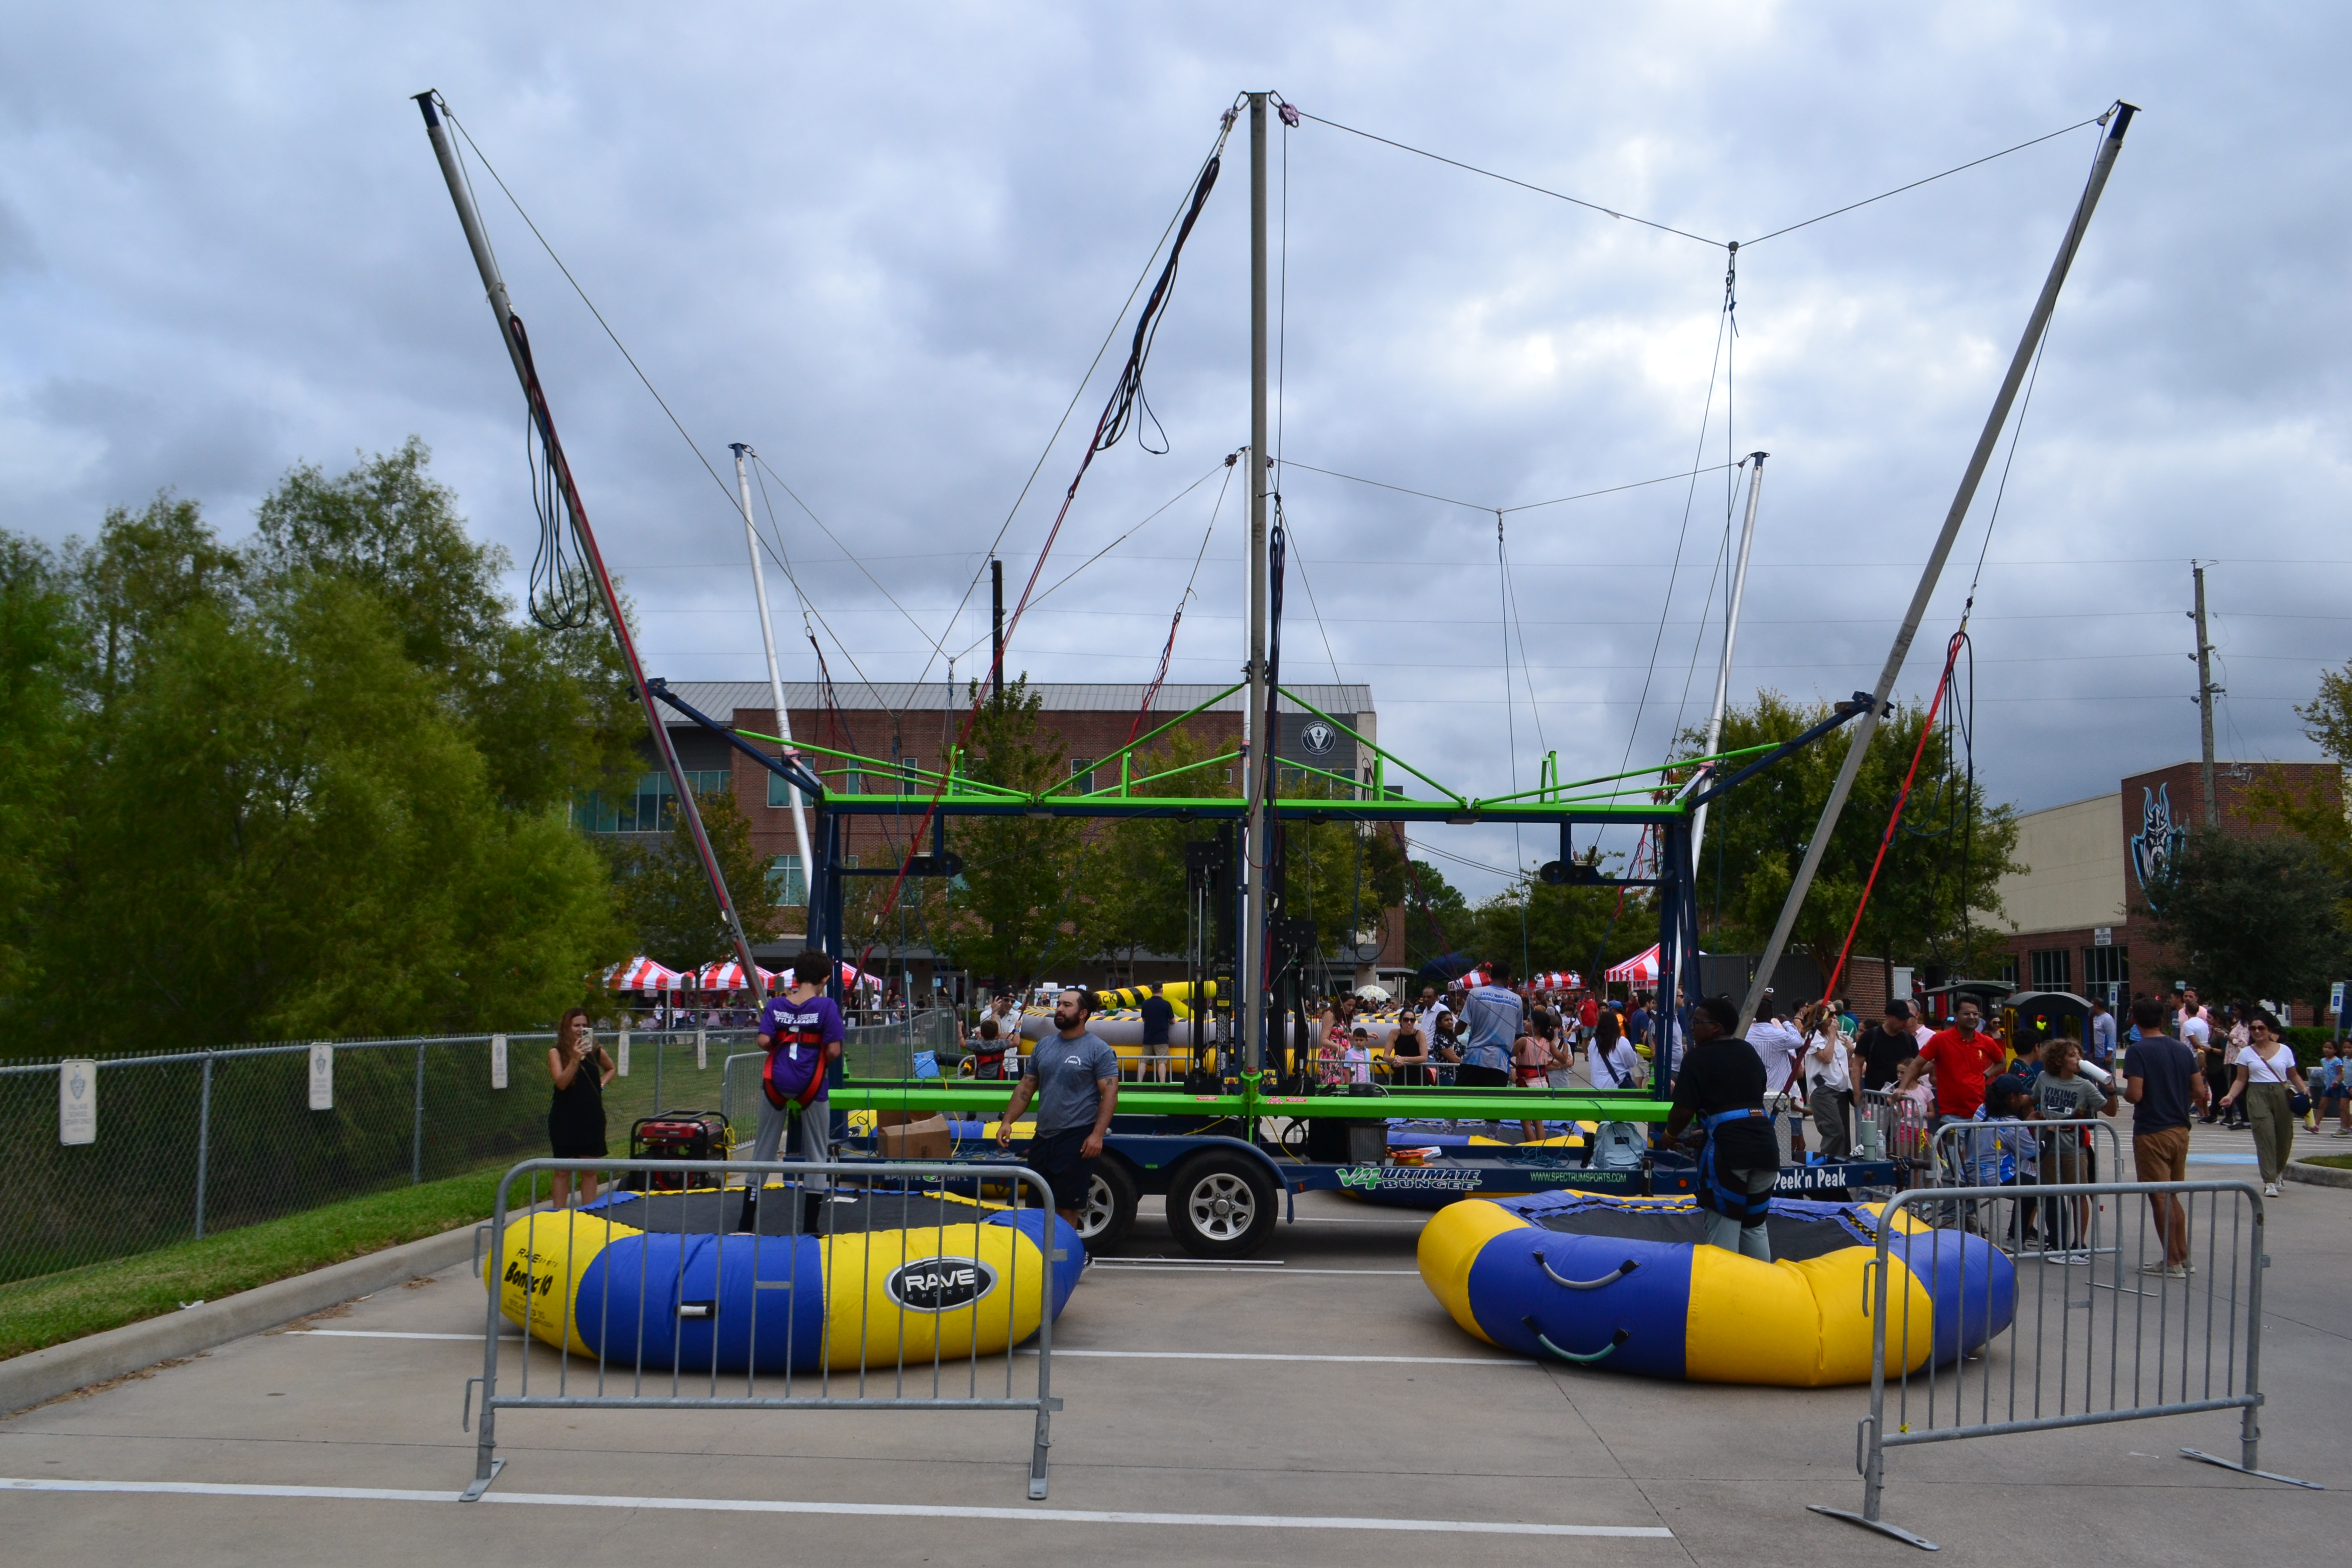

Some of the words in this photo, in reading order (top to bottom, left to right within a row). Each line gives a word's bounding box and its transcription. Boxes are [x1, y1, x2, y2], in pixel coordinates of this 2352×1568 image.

[1323, 724, 1333, 737] SCHOOL
[2045, 1086, 2078, 1100] VIKING
[2044, 1094, 2076, 1109] NATION
[1335, 1167, 1382, 1190] V4
[1382, 1168, 1481, 1181] ULTIMATE
[1383, 1180, 1474, 1190] BUNGEE
[1530, 1172, 1627, 1183] WWW.SPECTRUMSPORTS.COM
[1773, 1169, 1811, 1190] Peek'n
[1817, 1166, 1846, 1188] Peak
[516, 1248, 541, 1263] RAE
[538, 1275, 553, 1296] 10
[905, 1268, 975, 1292] RAVE
